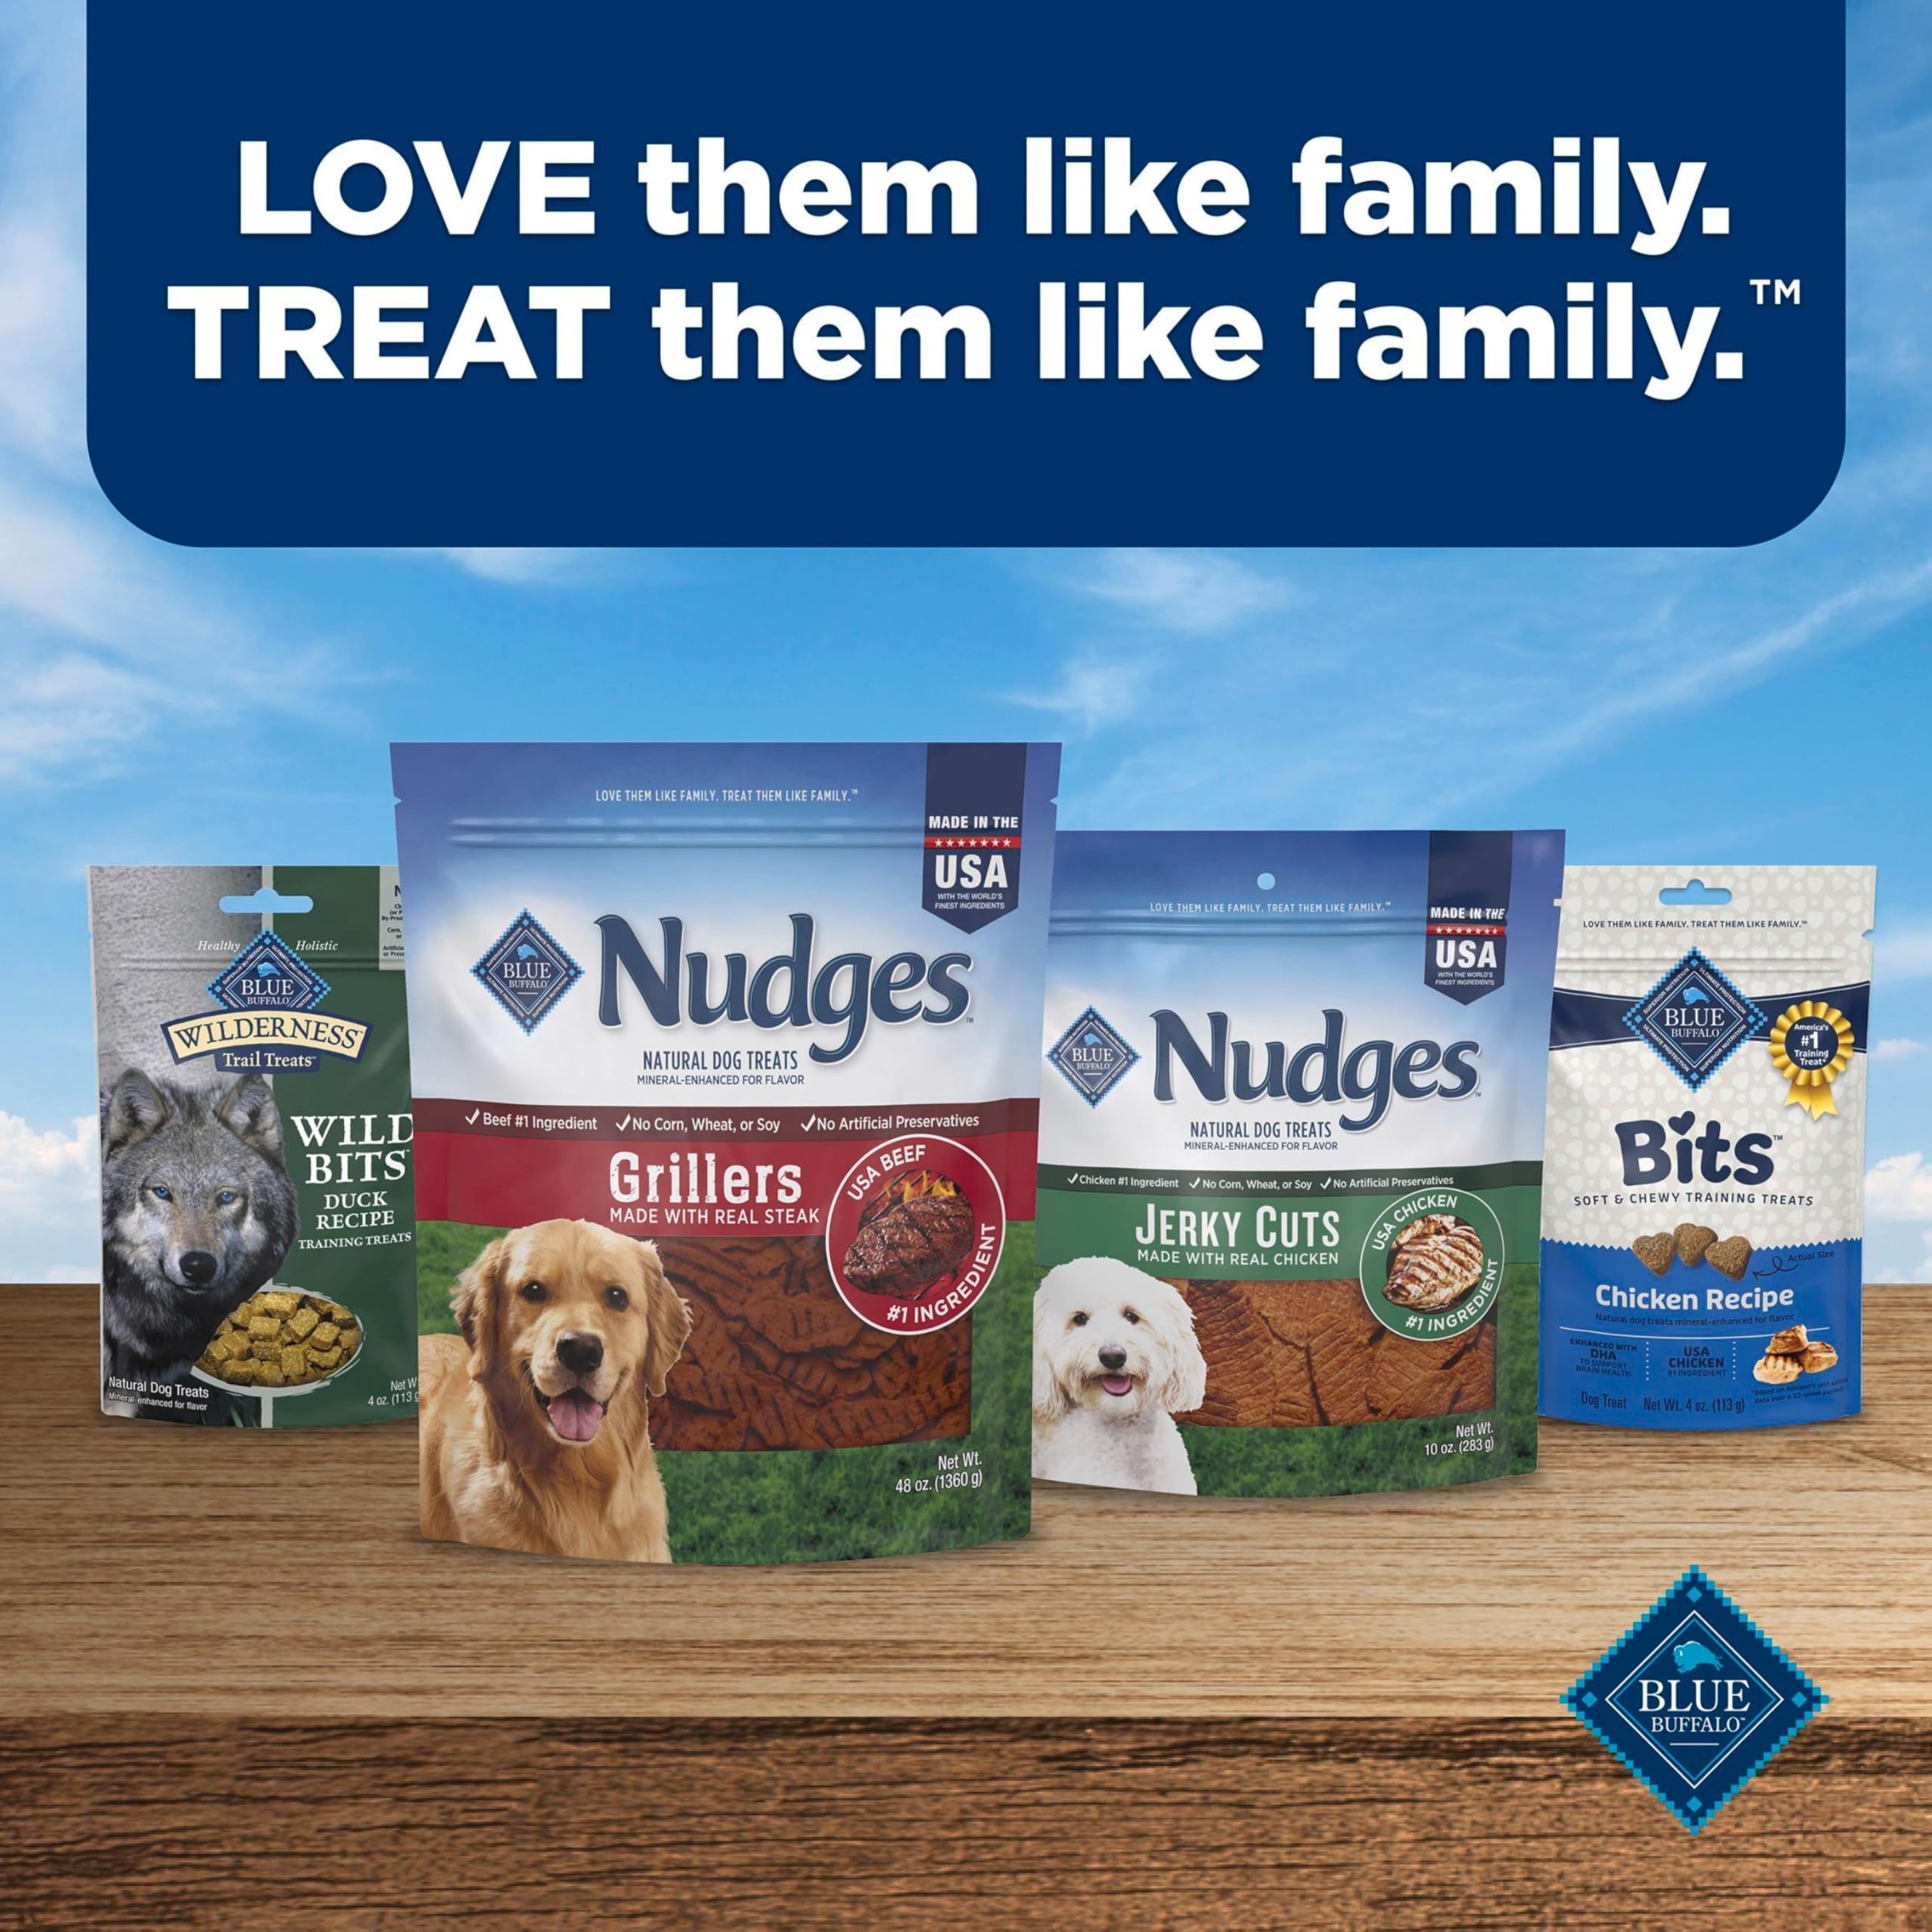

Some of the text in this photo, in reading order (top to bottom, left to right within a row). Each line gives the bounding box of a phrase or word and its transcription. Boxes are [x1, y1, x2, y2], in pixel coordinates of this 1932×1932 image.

[595, 789, 622, 801] LOVE
[625, 789, 651, 801] THEM
[655, 789, 677, 801] LIKE
[680, 789, 718, 801] FAMILY.
[722, 789, 752, 801] TREAT
[756, 789, 783, 801] THEM
[786, 789, 808, 801] LIKE
[929, 816, 1019, 829] MADE IN THE
[935, 854, 1008, 889] USA
[1430, 906, 1506, 919] MADE IN THE
[1583, 920, 1605, 928] LOVE
[1607, 920, 1632, 928] THEM
[1634, 920, 1653, 928] LIKE
[1655, 920, 1689, 928] FAMILY.
[1691, 920, 1718, 928] TREAT
[1720, 920, 1745, 928] THEM
[1746, 920, 1765, 928] LIKE
[198, 940, 240, 952] Healthy
[296, 940, 338, 951] Holistic
[1436, 940, 1497, 968] USA
[503, 962, 552, 979] BLUE
[242, 979, 294, 995] BLUE
[509, 980, 547, 989] BUFFALO
[594, 913, 973, 1064] Nudges
[247, 996, 290, 1005] BUFFALO
[1664, 1008, 1725, 1026] BLUE
[174, 1017, 358, 1050] WILDERNESS
[1672, 1028, 1719, 1038] BUFFALO
[1801, 1031, 1818, 1049] #1
[223, 1051, 311, 1067] Trail Treats
[643, 1050, 798, 1070] NATURAL DOG TREATS
[1072, 1048, 1114, 1062] BLUE
[1794, 1050, 1829, 1059] Training
[1077, 1062, 1110, 1070] BUFFALO
[1149, 1008, 1481, 1132] Nudges
[637, 1075, 804, 1085] MINERAL-ENHANCED FOR FLAVOR
[290, 1113, 414, 1147] WILD
[483, 1112, 598, 1132] Beef #1 Ingredient
[632, 1117, 780, 1134] No Corn, Wheat, or Soy
[817, 1113, 980, 1131] No Artificial Preservatives
[1190, 1121, 1332, 1138] NATURAL DOG TREATS
[1184, 1141, 1338, 1151] MINERAL-ENHANCED FOR FLAVOR
[1614, 1110, 1774, 1186] Bits
[306, 1149, 406, 1184] BITS
[847, 1144, 926, 1201] USA BEEF
[610, 1151, 801, 1204] Grillers
[1079, 1174, 1179, 1189] Chicken #1 Ingredient
[1203, 1179, 1312, 1192] No Corn, Wheat, or Soy
[1333, 1176, 1454, 1189] No Artificial Preservatives
[324, 1191, 388, 1210] DUCK
[1574, 1192, 1814, 1207] SOFT & CHEWY TRAINING TREATS
[316, 1210, 395, 1230] RECIPE
[610, 1208, 820, 1224] MADE WITH REAL STEAK
[1372, 1195, 1458, 1251] USA CHICKEN
[1136, 1203, 1340, 1248] JERKY CUTS
[298, 1232, 412, 1249] TRAINING TREATS
[1137, 1249, 1339, 1266] MADE WITH REAL CHICKEN
[1787, 1252, 1816, 1262] Actual
[886, 1223, 996, 1324] #1 INGREDIENT
[1405, 1258, 1498, 1331] #1 INGREDIENT
[1595, 1284, 1794, 1312] Chicken Recipe
[1684, 1346, 1709, 1357] USA
[1669, 1358, 1724, 1368] CHICKEN
[109, 1376, 210, 1398] Natural Dog Treats
[109, 1392, 208, 1411] Mineral-enhanced for flavor
[1581, 1391, 1627, 1409] Dog Treat
[1644, 1397, 1746, 1414] Net Wt. 4 oz. (113 g)
[1456, 1421, 1494, 1438] Net Wt.
[1425, 1435, 1494, 1456] 10 oz. (283 g)
[938, 1451, 982, 1471] Net Wt.
[895, 1469, 983, 1493] 48 oz. (1360 g)
